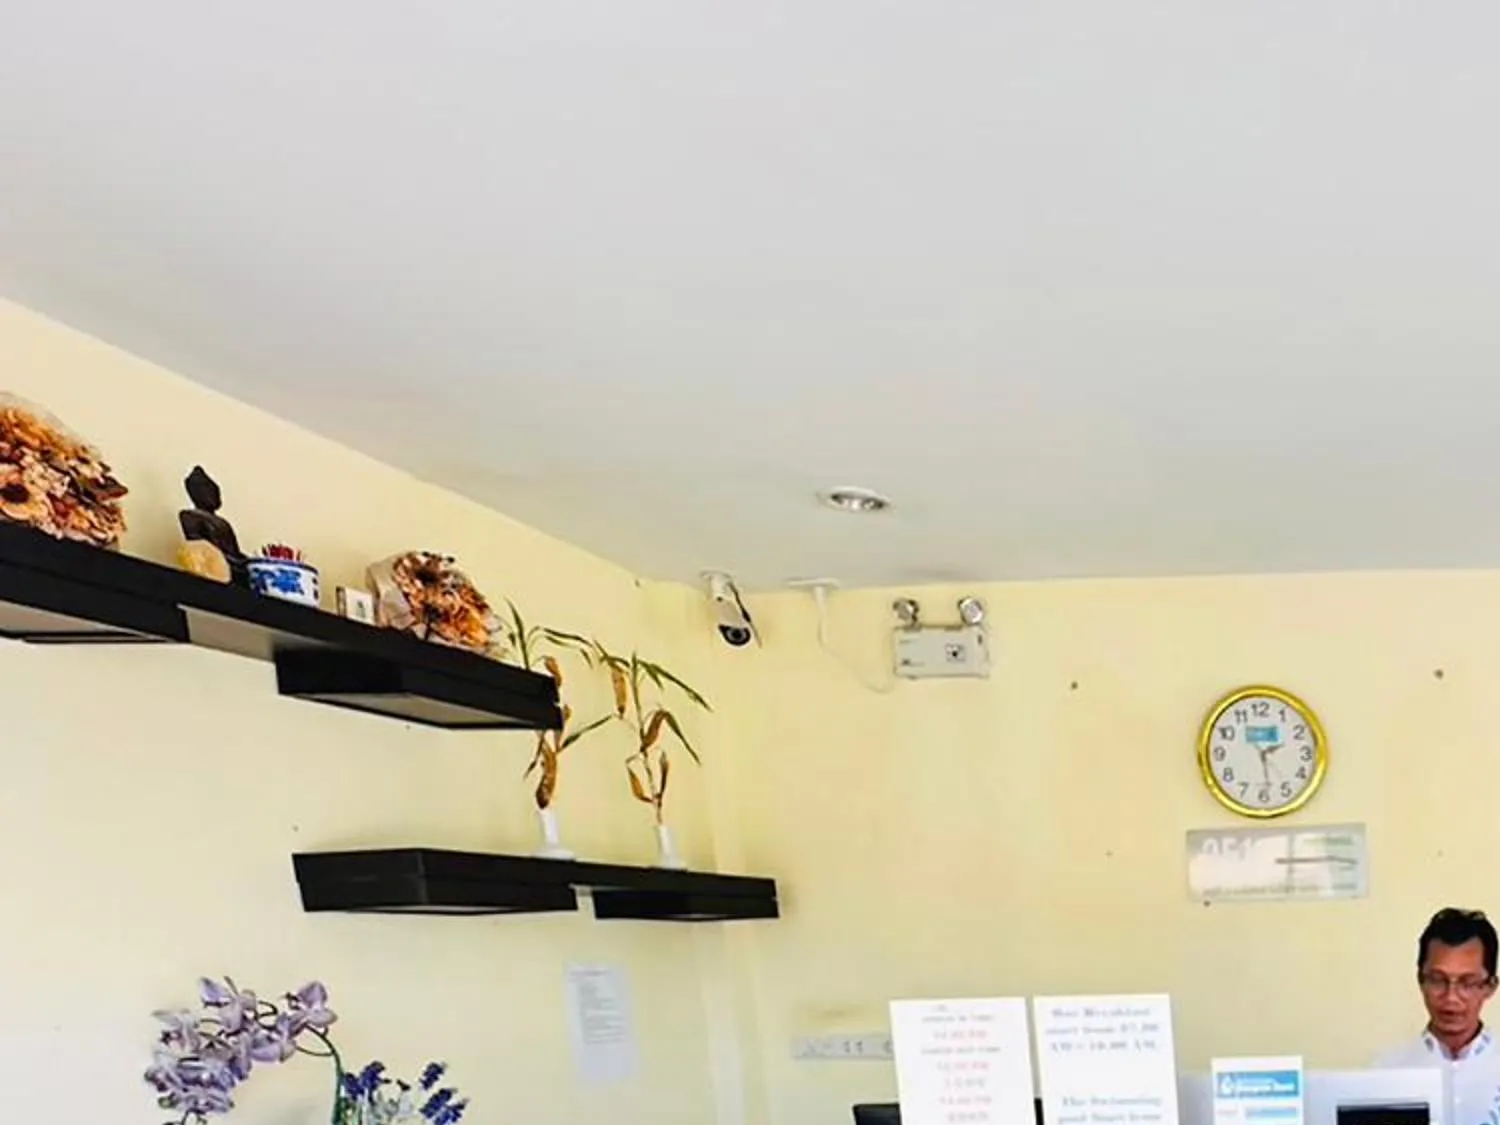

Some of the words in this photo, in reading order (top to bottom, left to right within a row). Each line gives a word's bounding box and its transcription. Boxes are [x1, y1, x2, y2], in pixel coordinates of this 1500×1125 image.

[1235, 709, 1248, 724] 11
[1251, 702, 1270, 717] 12
[1278, 709, 1286, 722] 1
[1219, 726, 1235, 741] 10
[1293, 725, 1305, 740] 2
[1214, 747, 1226, 761] 9
[1300, 746, 1312, 761] 3
[1223, 767, 1234, 782] 8
[1296, 767, 1306, 779] 4
[1238, 782, 1249, 797] 7
[1258, 789, 1270, 803] 6
[1280, 782, 1292, 797] 5
